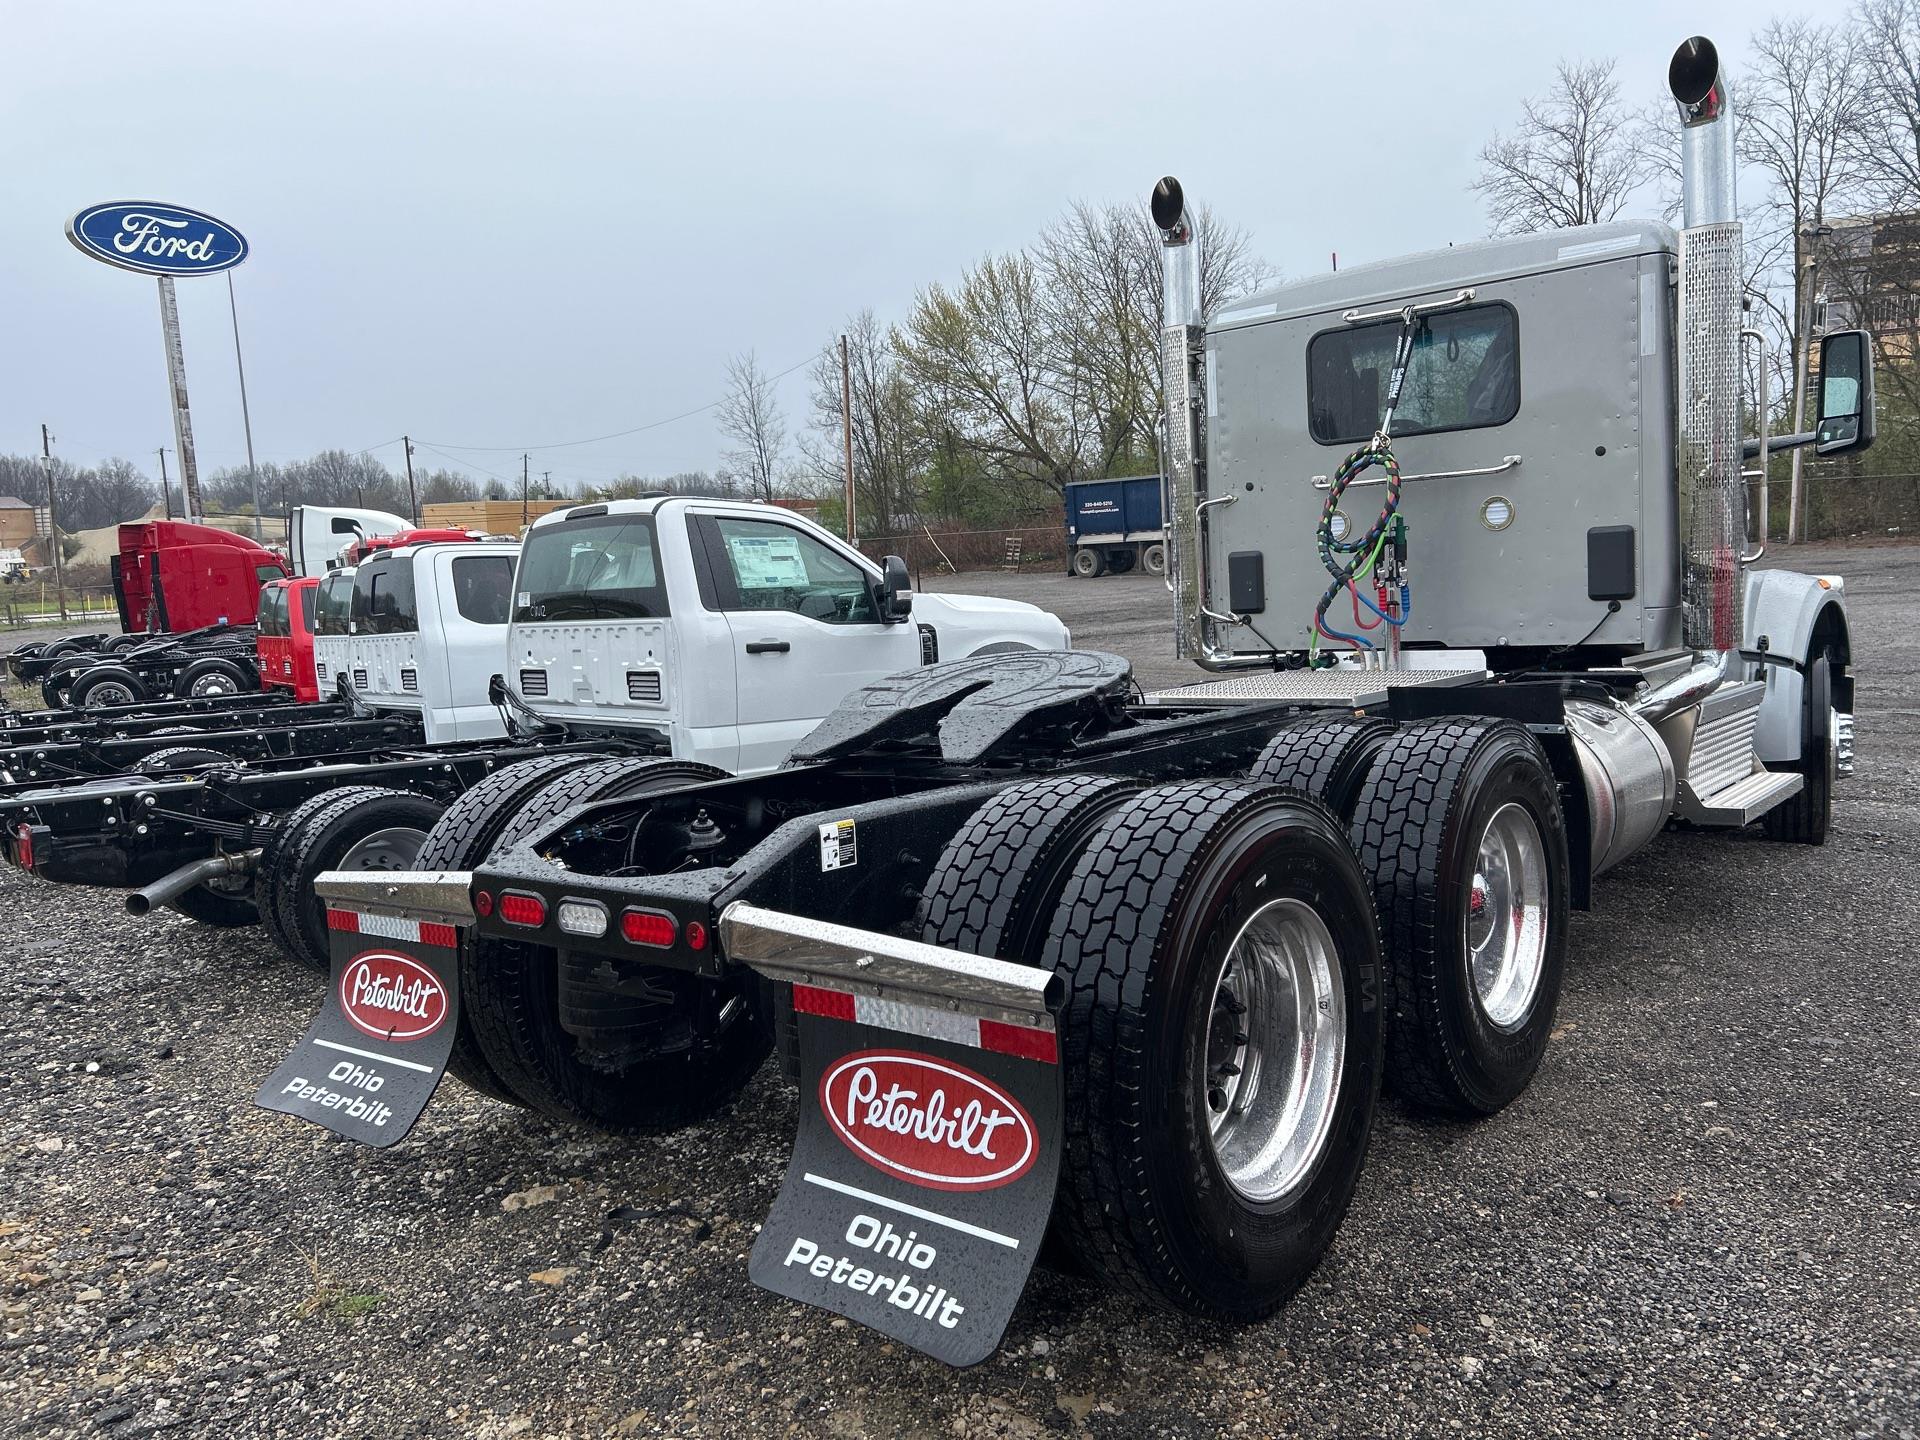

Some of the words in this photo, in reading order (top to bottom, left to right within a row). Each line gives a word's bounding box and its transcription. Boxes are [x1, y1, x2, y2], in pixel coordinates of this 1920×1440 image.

[113, 213, 215, 262] Ford
[351, 963, 438, 1019] Peterbilt
[280, 1076, 393, 1127] Peterbilt
[327, 1060, 386, 1093] Ohio
[846, 1066, 1016, 1161] Peterbilt
[844, 1213, 937, 1271] Ohio
[782, 1236, 965, 1330] Peterbilt
